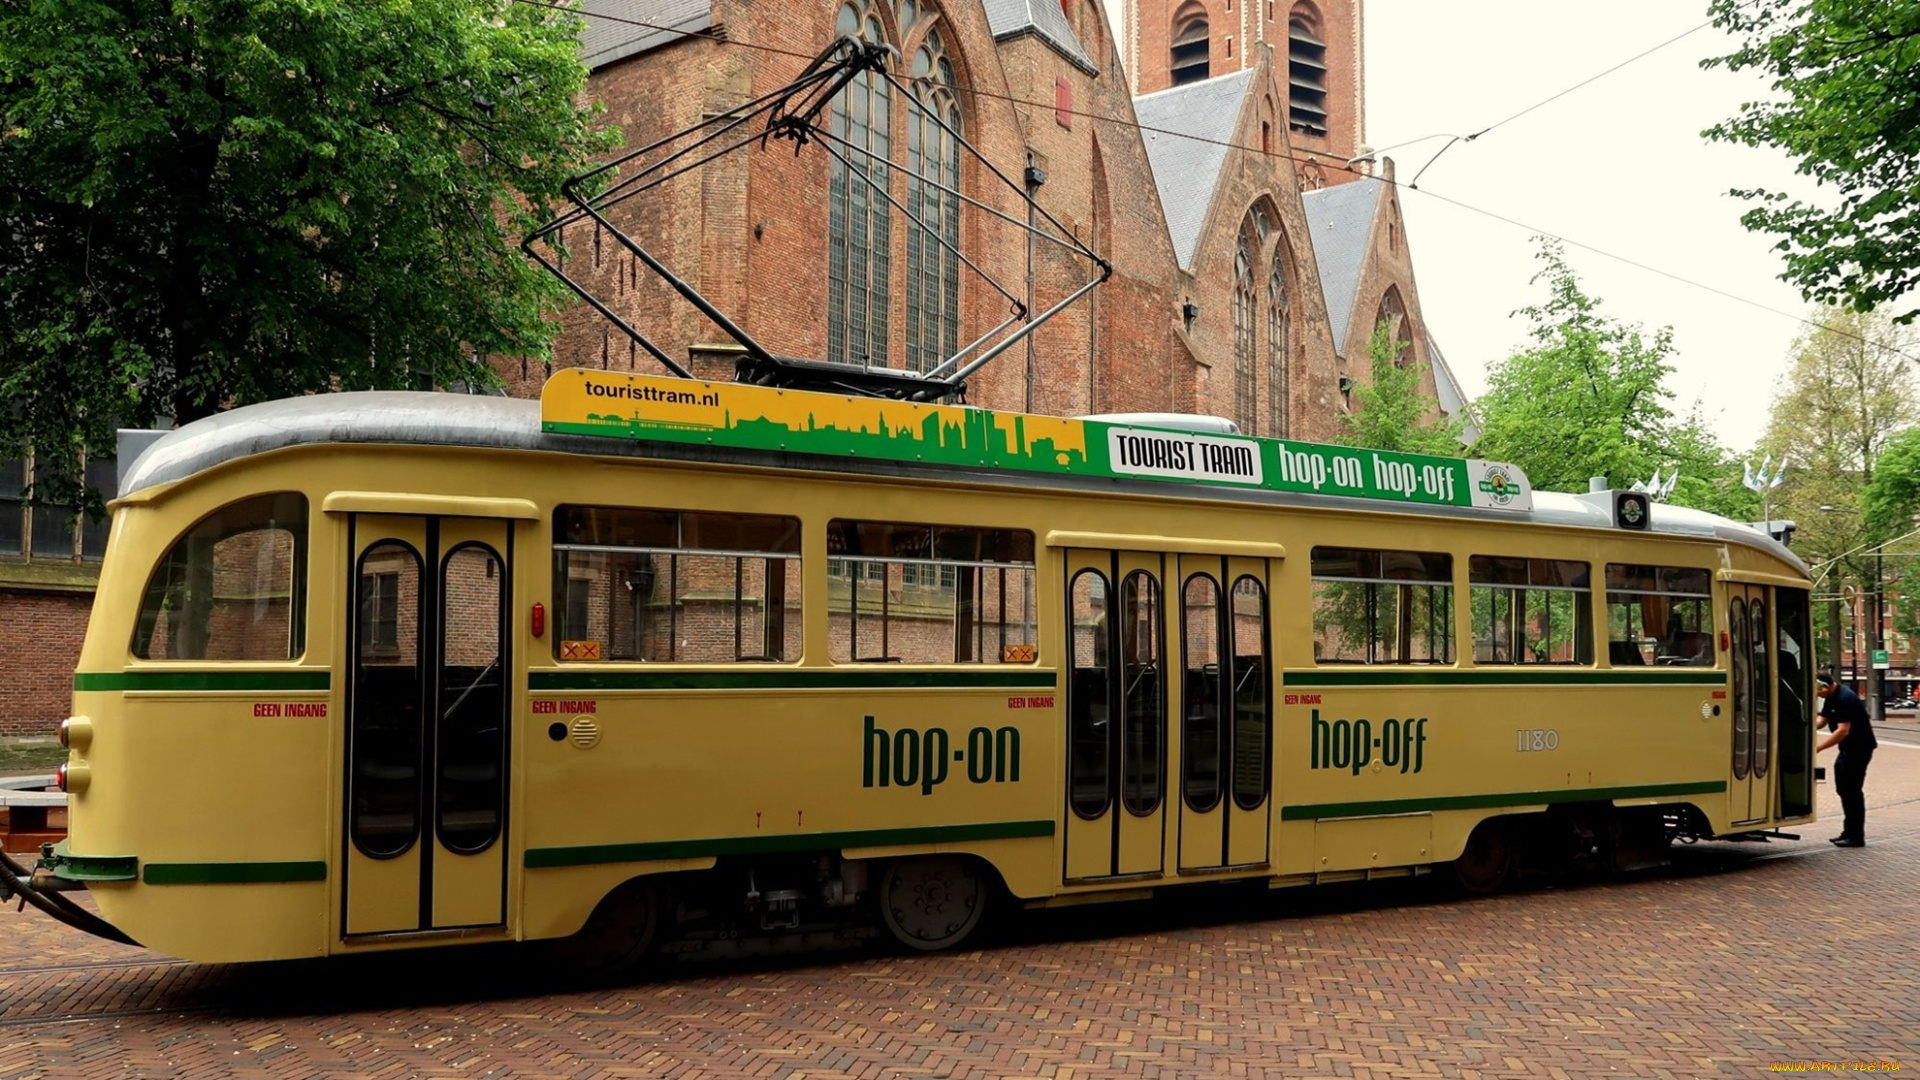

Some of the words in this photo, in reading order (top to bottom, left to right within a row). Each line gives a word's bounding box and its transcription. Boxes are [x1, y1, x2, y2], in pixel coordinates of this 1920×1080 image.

[585, 381, 719, 407] touristtram.nl
[1116, 434, 1195, 471] TOURIST
[1199, 443, 1254, 476] TRAM
[254, 703, 281, 717] GEEN
[284, 703, 327, 717] INGANG
[532, 700, 557, 714] GEEN
[560, 700, 596, 714] INGANG
[1008, 697, 1026, 708] GEEN
[1027, 696, 1054, 708] INGANG
[1516, 729, 1559, 752] 1180
